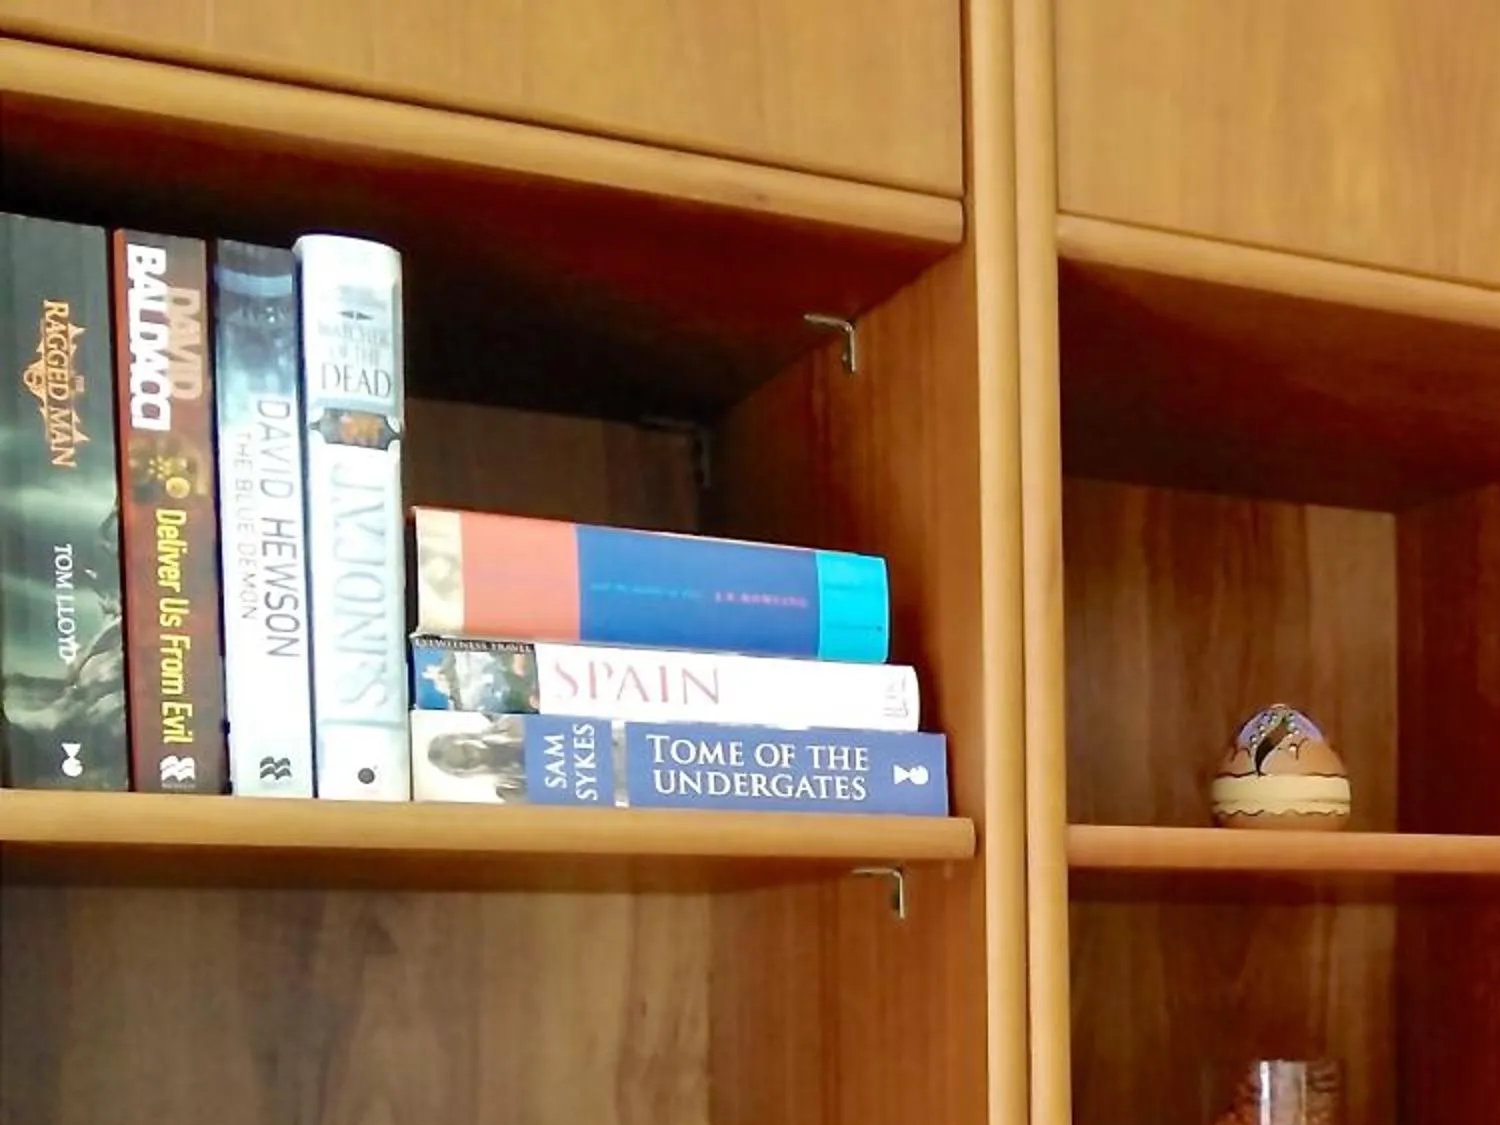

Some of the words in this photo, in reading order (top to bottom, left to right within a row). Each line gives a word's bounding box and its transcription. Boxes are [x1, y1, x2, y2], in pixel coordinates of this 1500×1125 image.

[44, 300, 69, 400] RAGGED
[127, 243, 172, 431] BALDACCI
[167, 286, 202, 400] DAVID
[321, 362, 392, 399] DEAD
[50, 407, 77, 467] MAN
[235, 432, 252, 470] THE
[257, 399, 292, 499] DAVID
[236, 478, 254, 532] BLUE
[52, 544, 73, 588] TOM
[156, 508, 187, 592] Deliver
[238, 541, 258, 620] DEMON
[261, 516, 300, 658] HEWSON
[53, 593, 77, 664] LLOYD
[158, 597, 190, 628] Us
[160, 633, 192, 696] From
[552, 659, 720, 706] SPAIN
[163, 702, 192, 744] Evil
[646, 734, 745, 767] TOME
[754, 741, 796, 769] OF
[806, 745, 870, 772] THE
[544, 733, 567, 789] SAM
[572, 722, 598, 801] SYKES
[652, 769, 868, 801] UNDERGATES
